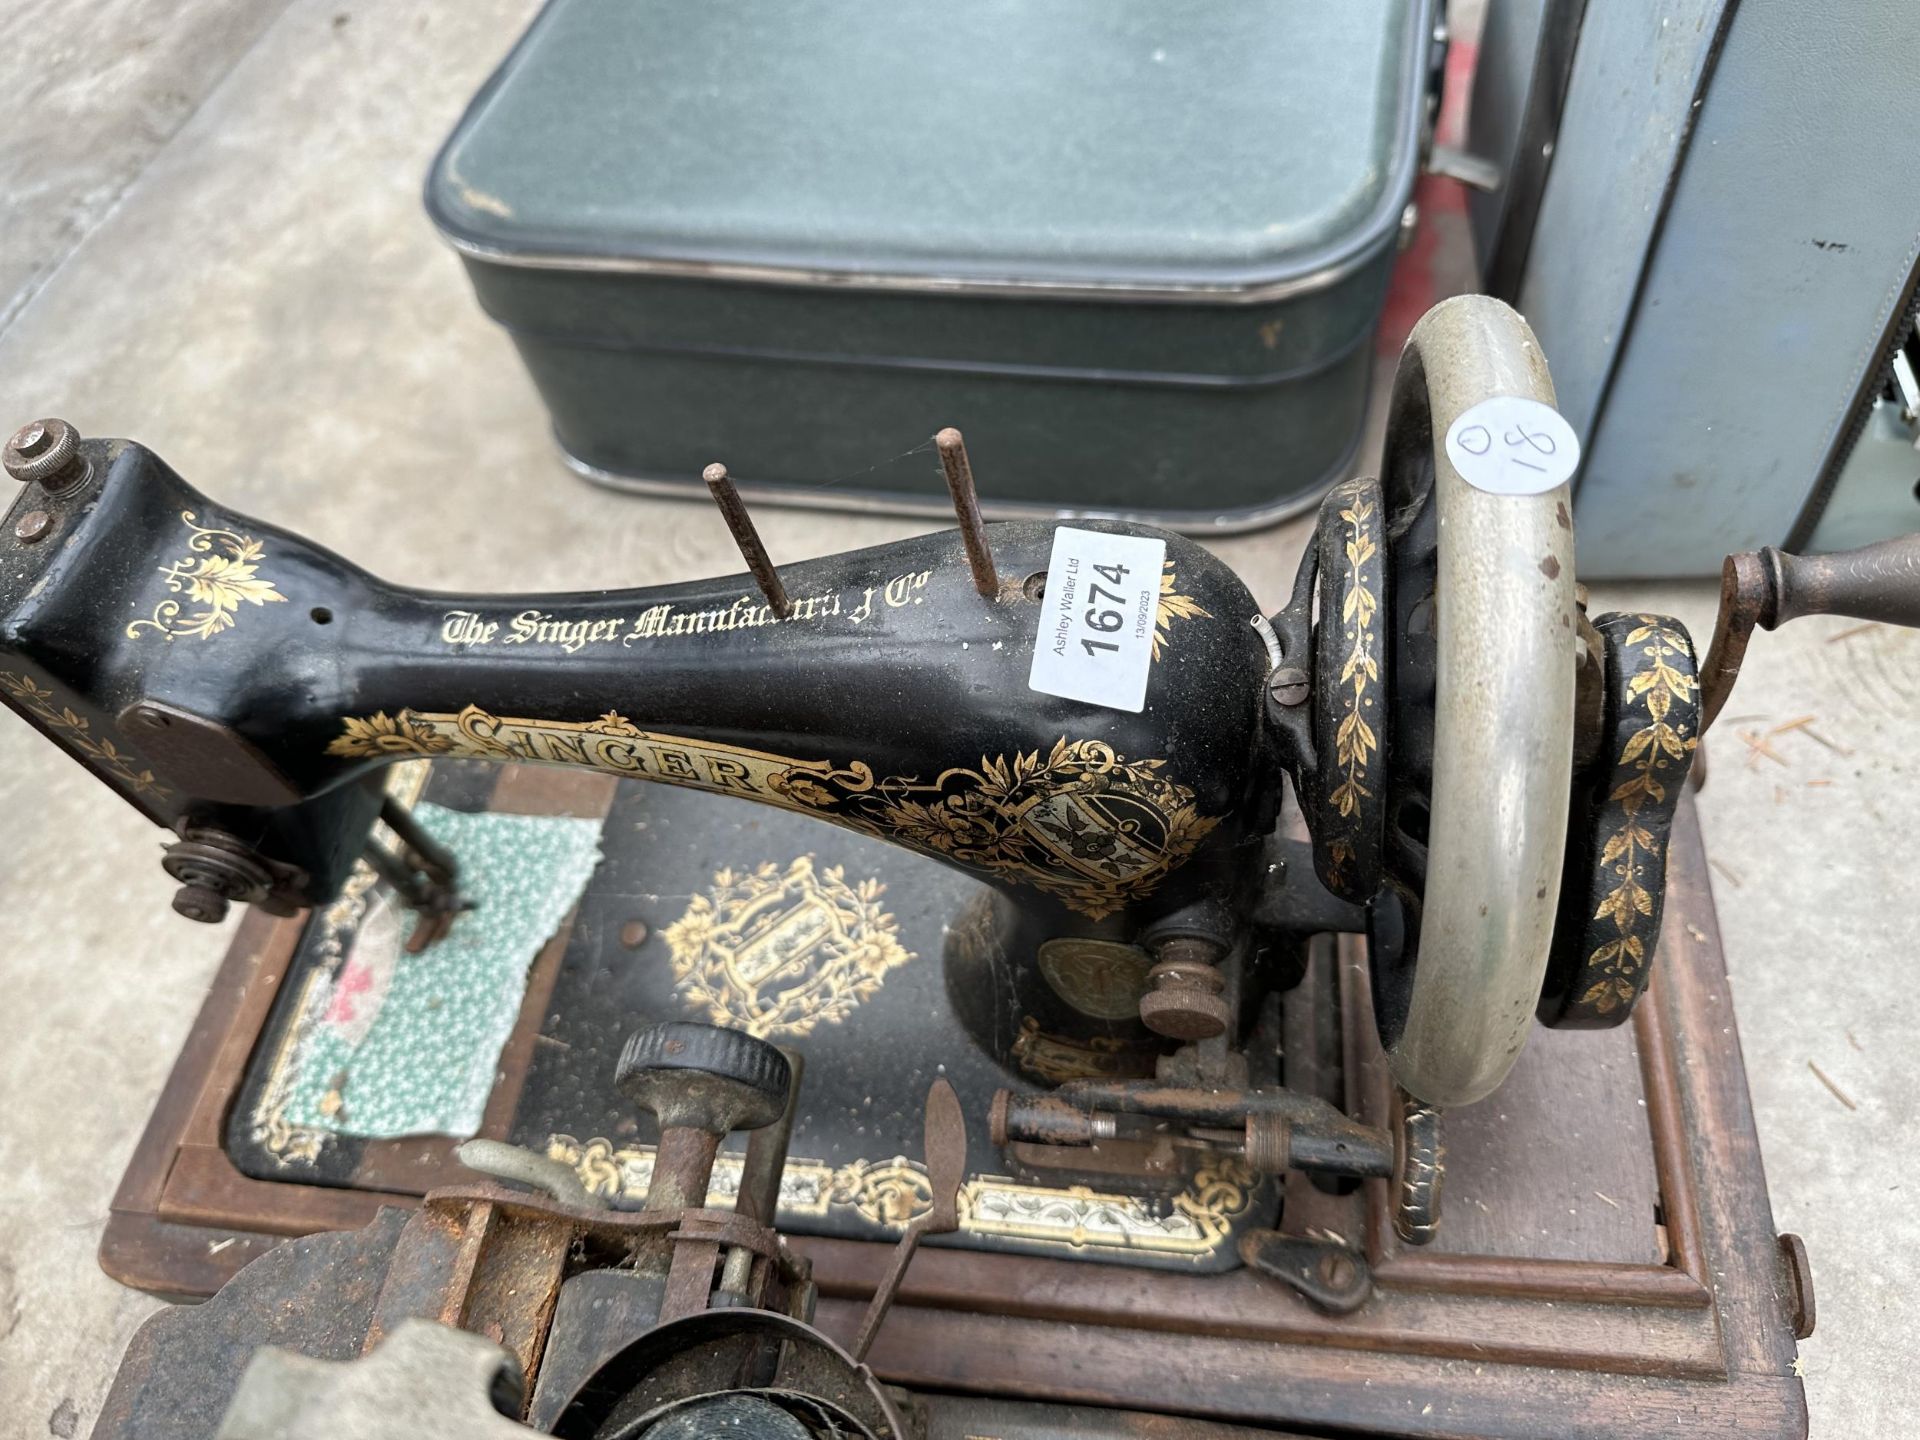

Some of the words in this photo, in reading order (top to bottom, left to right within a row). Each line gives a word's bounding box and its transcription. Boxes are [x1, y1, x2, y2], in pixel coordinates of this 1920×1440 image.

[1068, 557, 1080, 575] Ltd
[1060, 575, 1076, 612] Waller
[1081, 564, 1130, 657] 1674
[1136, 590, 1151, 640] 13/09/2023
[442, 610, 499, 647] The
[503, 609, 625, 653] Singer
[1053, 614, 1073, 656] Ashley
[457, 704, 761, 794] SINGER
